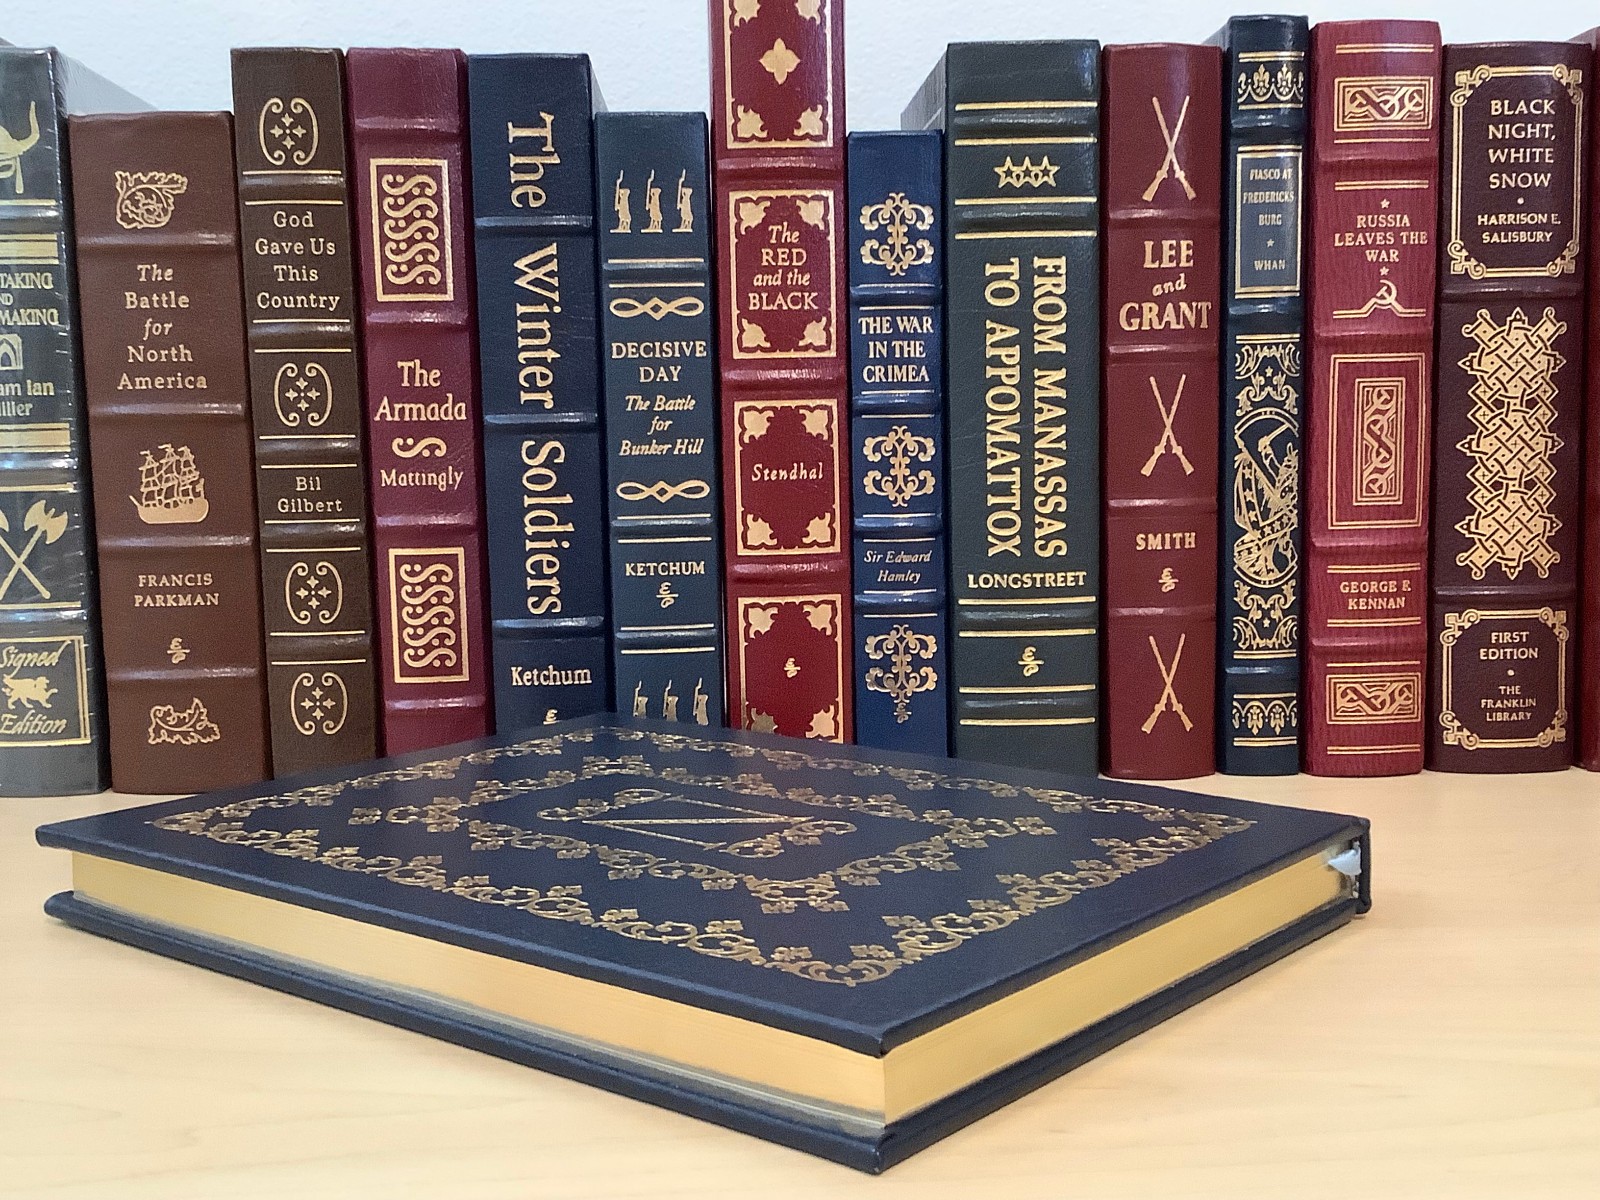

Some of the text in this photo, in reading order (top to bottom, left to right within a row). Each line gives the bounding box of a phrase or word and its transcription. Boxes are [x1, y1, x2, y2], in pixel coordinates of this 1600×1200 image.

[1491, 99, 1555, 115] BLACK
[1489, 123, 1555, 140] NIGHT,
[1489, 148, 1553, 163] WHITE
[1249, 168, 1293, 181] FIASCO AT
[1490, 173, 1551, 188] SNOW
[1243, 191, 1295, 204] FREDERICKS
[274, 211, 314, 227] God
[1259, 214, 1281, 225] BURG
[1357, 214, 1410, 228] RUSSIA
[1478, 213, 1547, 225] HARRISON
[769, 222, 799, 243] The
[1335, 232, 1427, 246] LEAVES THE
[1483, 231, 1552, 243] SALISBURY
[255, 238, 335, 255] Gave Us
[1144, 240, 1193, 268] LEE
[762, 248, 806, 265] RED
[1366, 249, 1399, 262] WAR
[137, 264, 173, 281] The
[274, 265, 318, 281] This
[1255, 260, 1285, 270] WHAN
[754, 269, 810, 286] and the
[1153, 273, 1186, 296] and
[125, 291, 189, 309] Battle
[257, 292, 340, 311] Country
[749, 292, 818, 310] BLACK
[1120, 302, 1211, 330] GRANT
[143, 318, 172, 340] for
[858, 316, 933, 334] THE WAR
[127, 346, 193, 363] North
[612, 341, 706, 358] DECISIVE
[869, 341, 926, 358] IN THE
[508, 112, 574, 614] The Winter Soldiers
[117, 373, 207, 389] America
[397, 359, 440, 387] The
[640, 366, 681, 382] DAY
[863, 365, 929, 383] CRIMEA
[374, 393, 466, 421] Armada
[626, 395, 695, 411] The Battle
[985, 258, 1021, 556] TO APPOMATTOX
[1033, 256, 1067, 557] FROM MANASSAS
[647, 416, 673, 435] for
[619, 439, 704, 455] Bunker Hill
[381, 466, 463, 491] Mattingly
[752, 462, 823, 481] Stendhal
[296, 477, 320, 491] Bil
[278, 498, 342, 512] Gilbert
[1136, 532, 1195, 550] SMITH
[864, 550, 932, 563] Sir Edward
[626, 561, 704, 576] KETCHUM
[138, 574, 212, 587] FRANCIS
[878, 570, 920, 584] Hamley
[968, 572, 1086, 588] LONGSTREET
[1340, 581, 1397, 593] GEORGE
[135, 593, 219, 607] PARKMAN
[1348, 596, 1405, 609] KENNAN
[1492, 632, 1529, 643] FIRST
[0, 640, 71, 677] Signed
[1480, 648, 1538, 659] EDITION
[511, 665, 592, 685] Ketchum
[1498, 686, 1521, 694] THE
[1481, 699, 1536, 708] FRANKLIN
[0, 709, 67, 734] Edition
[1487, 712, 1531, 721] LIBRARY
